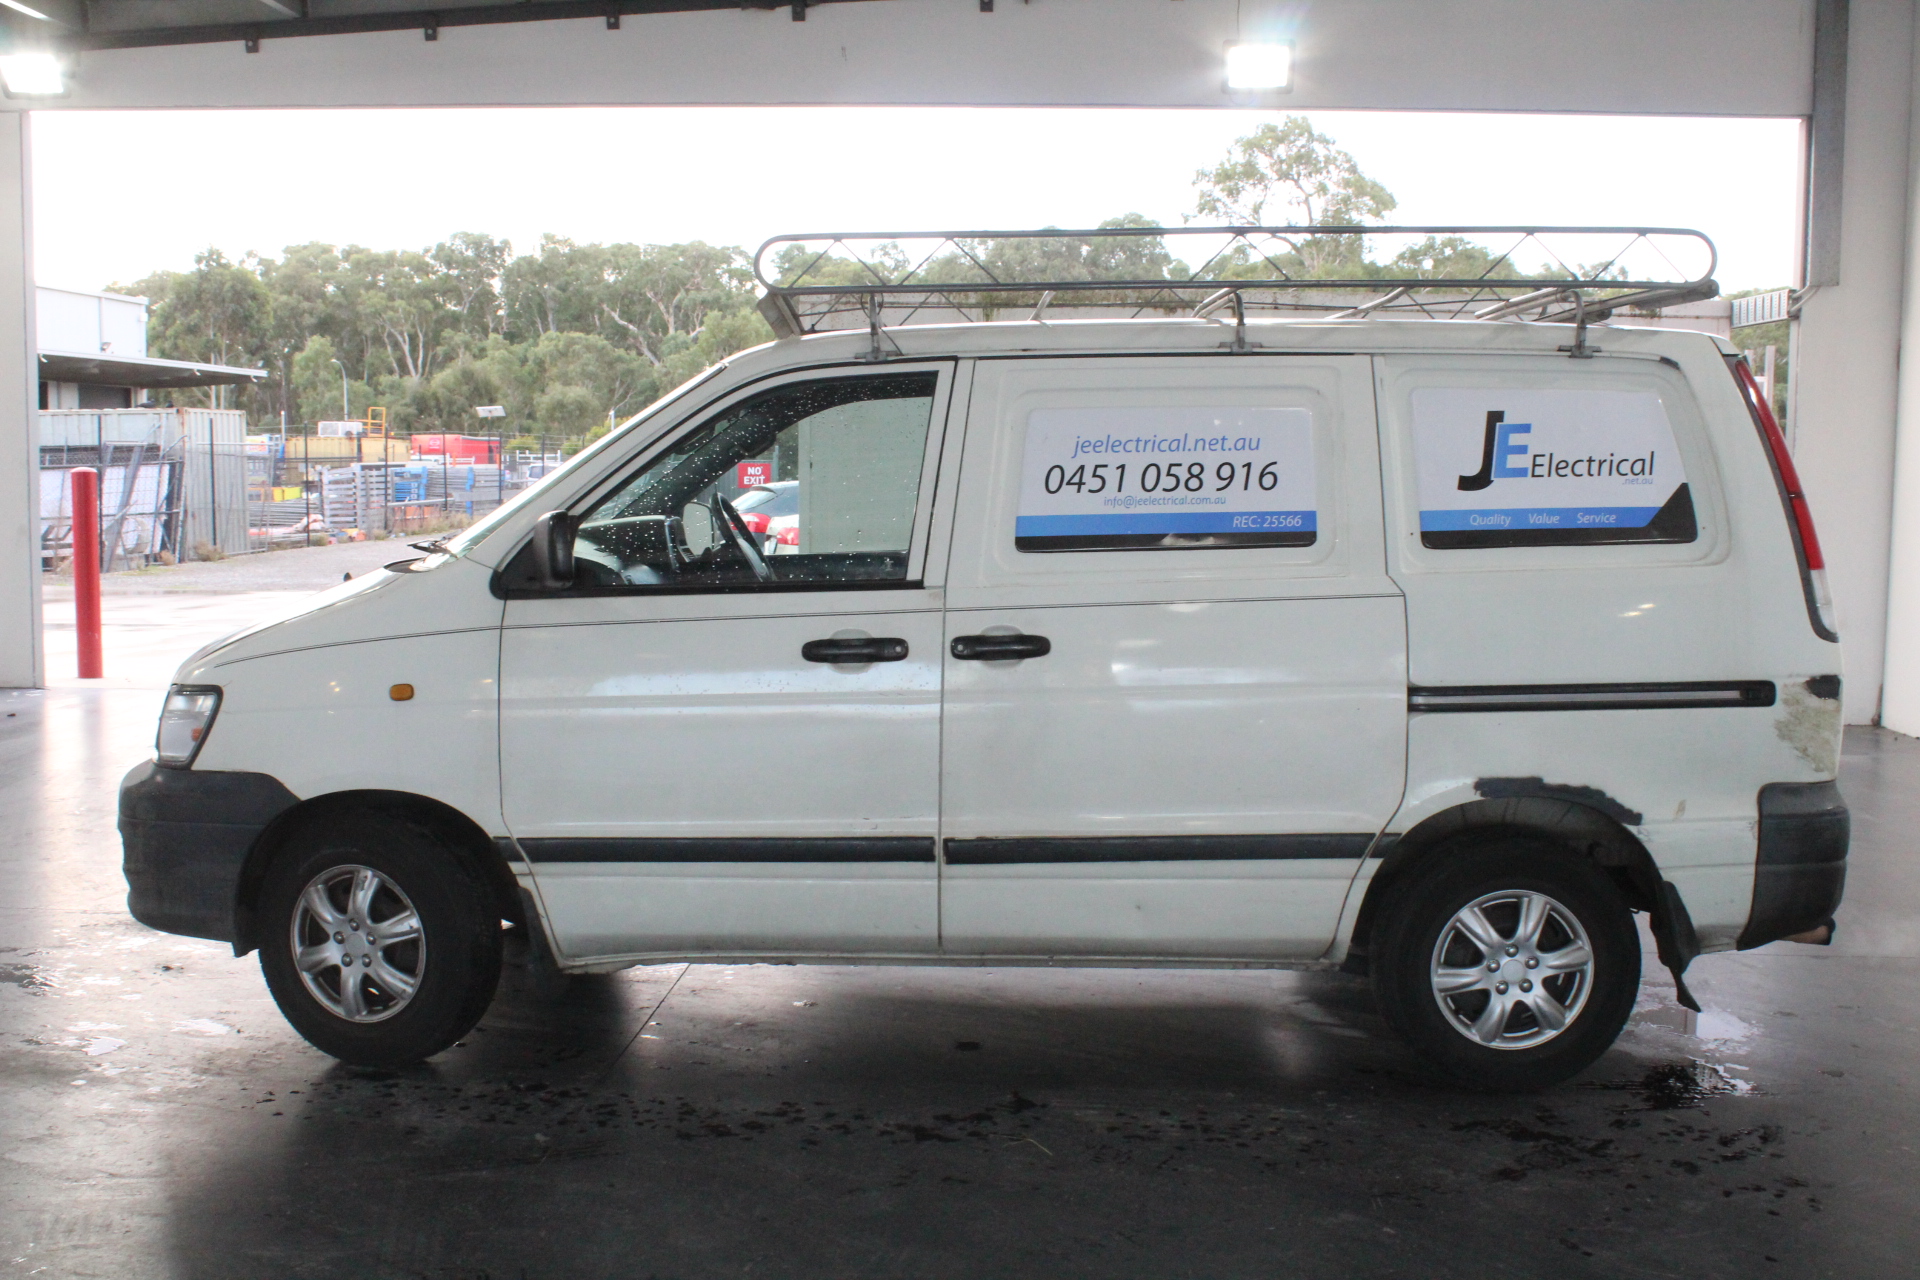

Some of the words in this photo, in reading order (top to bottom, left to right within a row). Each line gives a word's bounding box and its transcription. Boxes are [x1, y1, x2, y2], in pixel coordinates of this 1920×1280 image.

[1071, 433, 1261, 459] jeelectrical.net.au
[747, 467, 762, 475] NO
[1530, 451, 1655, 478] Electrical
[743, 476, 765, 484] EXIT
[1044, 464, 1126, 494] 0451
[1140, 462, 1205, 492] 058
[1215, 461, 1278, 491] 916
[1621, 476, 1654, 486] .net.au
[1103, 495, 1227, 508] info@jeelectrical.com.au
[1232, 515, 1261, 528] REC:
[1262, 514, 1303, 528] 25566
[1470, 513, 1512, 527] Quality
[1528, 512, 1560, 524] Value
[1576, 512, 1617, 524] Service
